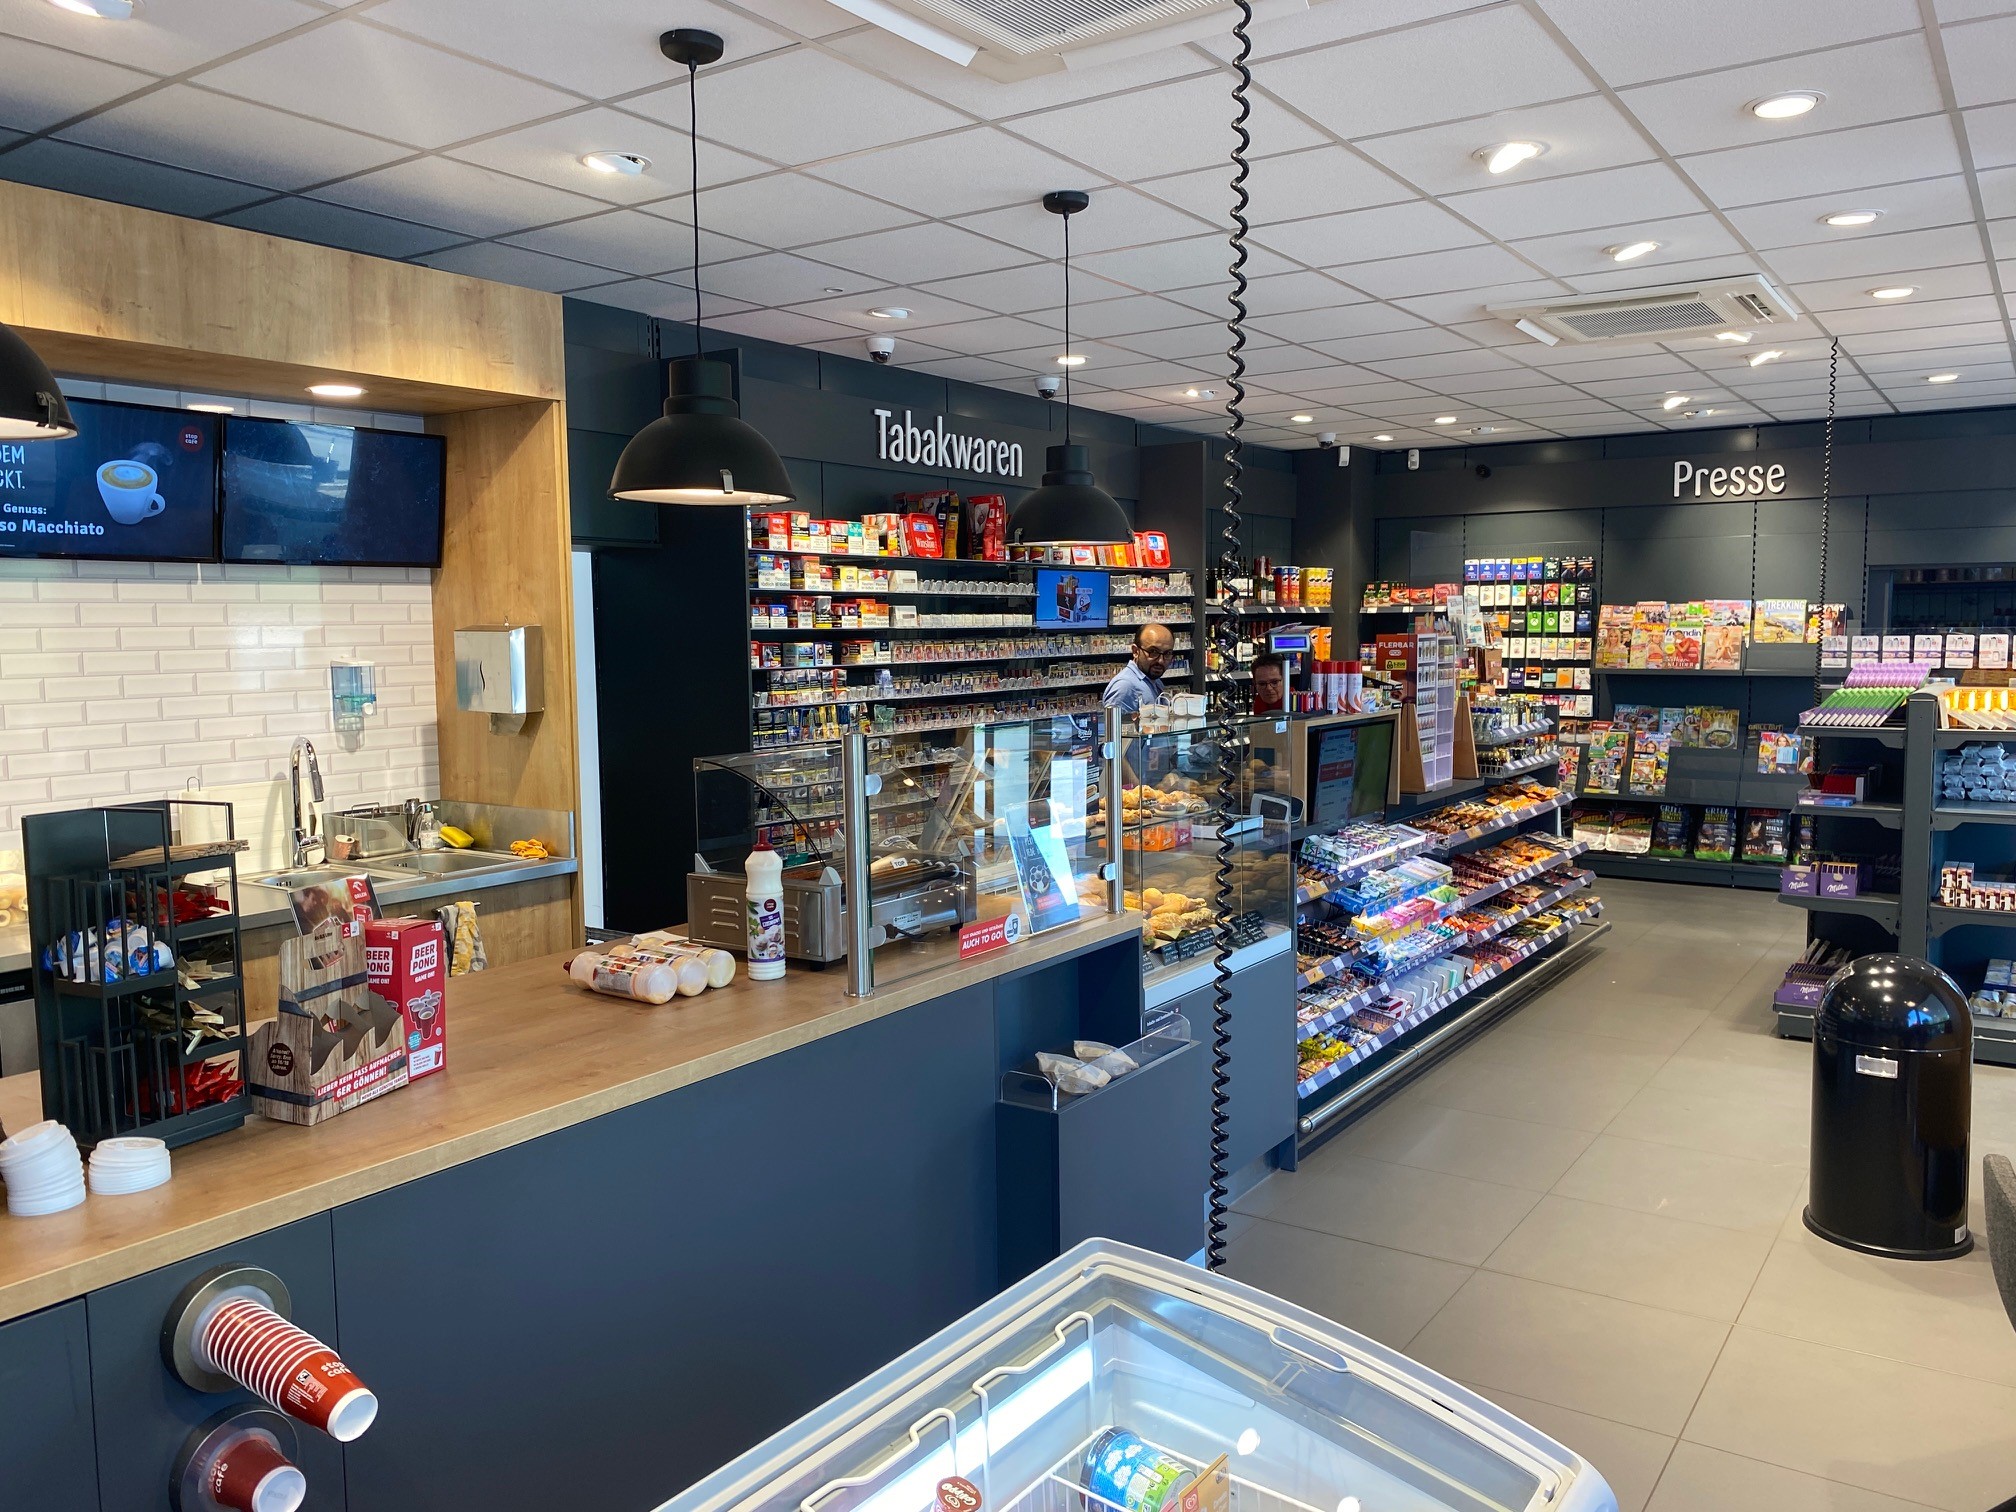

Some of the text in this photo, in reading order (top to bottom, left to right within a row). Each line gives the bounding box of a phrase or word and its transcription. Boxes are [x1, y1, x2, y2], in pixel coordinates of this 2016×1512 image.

[874, 408, 1023, 477] Tabakwaren
[0, 445, 25, 464] EM
[1673, 460, 1786, 497] Presse
[3, 503, 47, 514] Genuss:
[22, 519, 105, 536] Macchiato
[1767, 600, 1807, 610] TREKKING
[1788, 882, 1809, 890] Milka
[1827, 884, 1848, 892] Milka
[962, 930, 1003, 950] AUCH TO GO!
[414, 944, 434, 960] BEER
[412, 956, 434, 972] PONG
[1800, 986, 1818, 994] Milka
[318, 1080, 338, 1096] LIEBER
[338, 1074, 353, 1086] KEIN
[354, 1067, 368, 1080] FASS
[336, 1066, 388, 1098] 6ER GÖNNEN!
